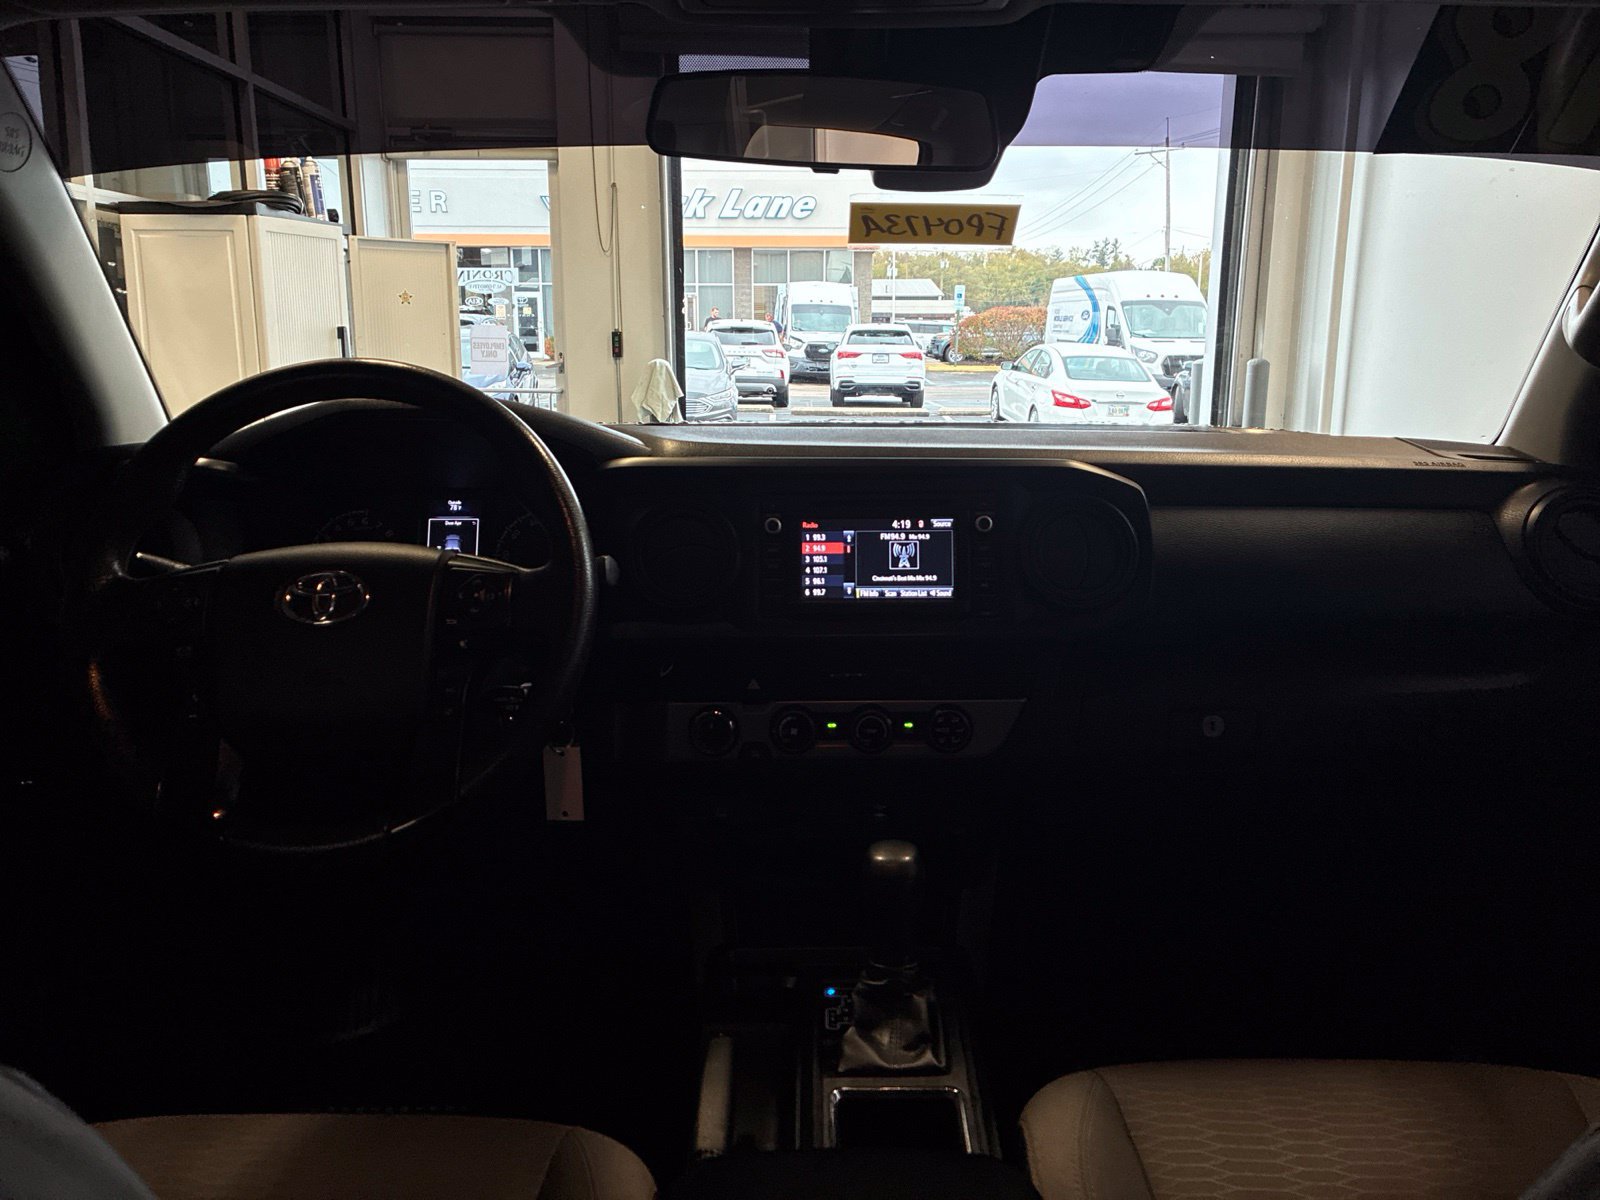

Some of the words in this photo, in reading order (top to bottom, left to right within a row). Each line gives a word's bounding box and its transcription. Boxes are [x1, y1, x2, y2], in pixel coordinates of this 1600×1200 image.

[718, 188, 817, 220] Lane
[892, 519, 911, 529] 4:19
[932, 520, 952, 528] Source
[805, 533, 810, 541] 1
[936, 589, 952, 597] Sound
